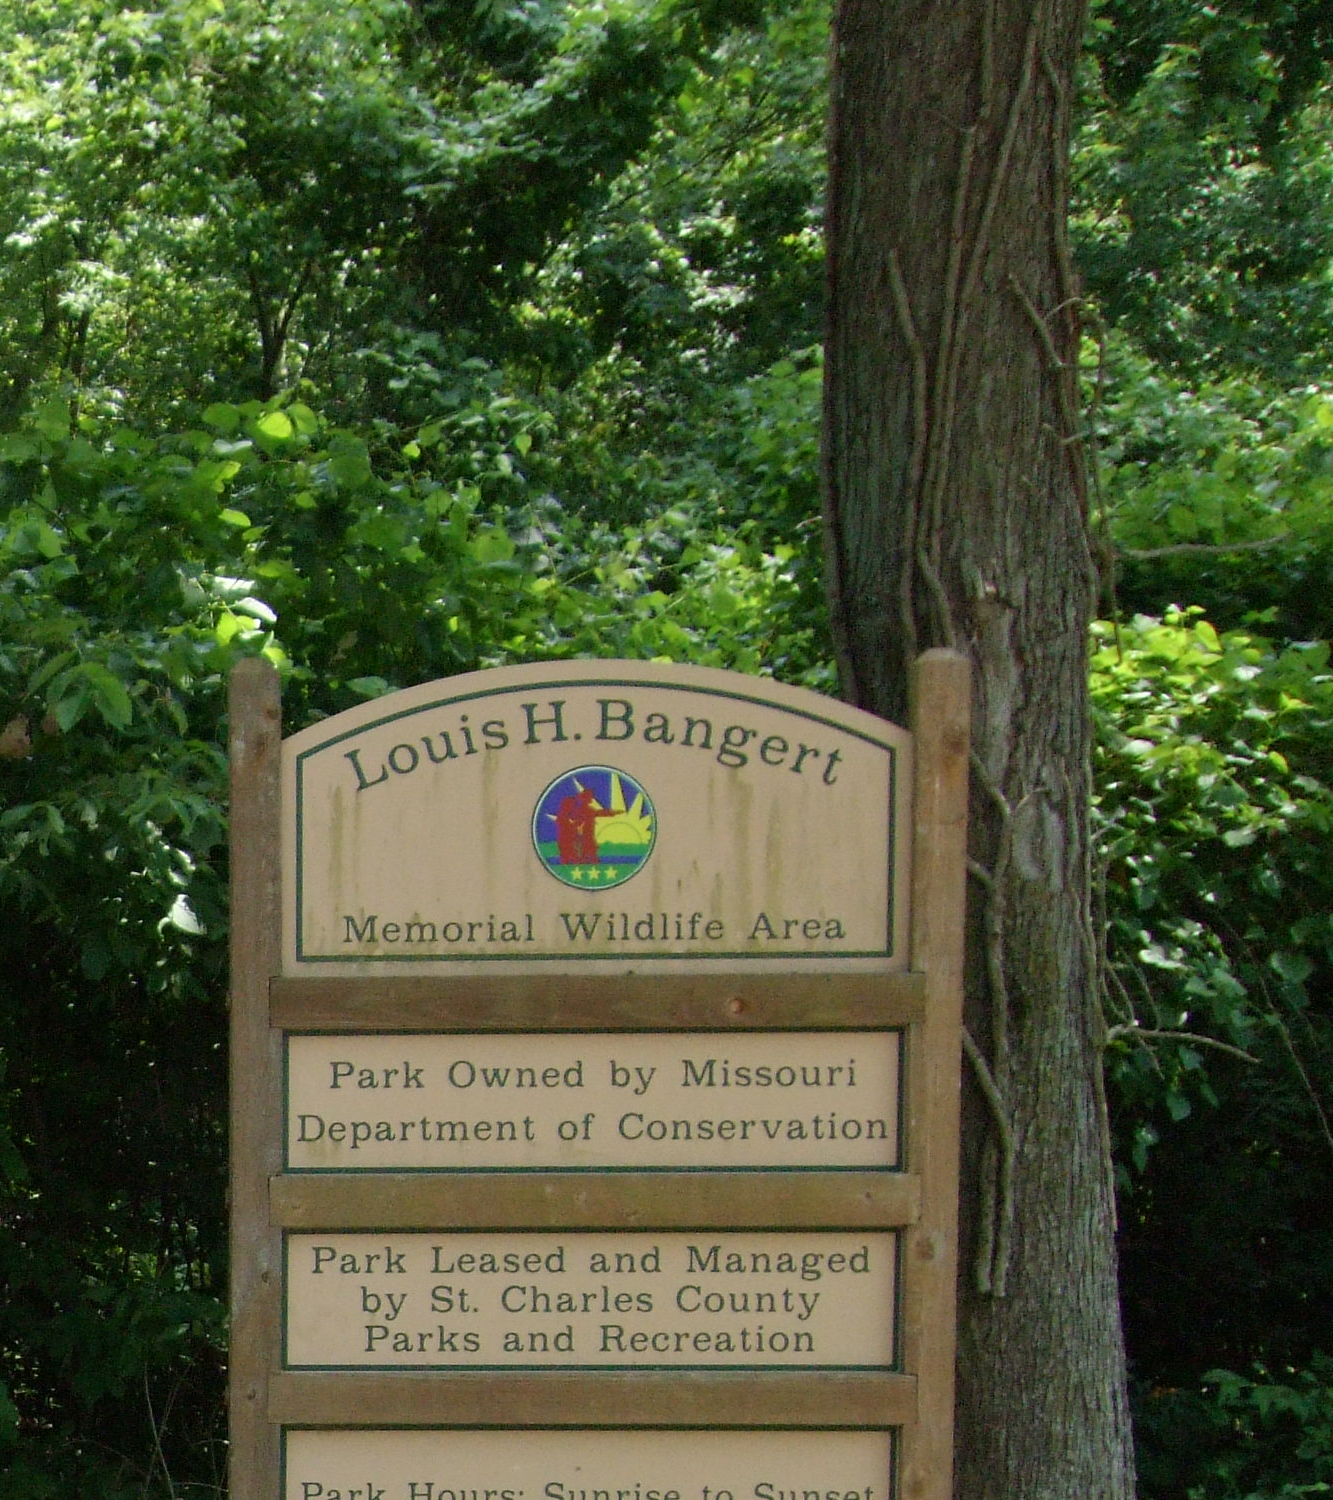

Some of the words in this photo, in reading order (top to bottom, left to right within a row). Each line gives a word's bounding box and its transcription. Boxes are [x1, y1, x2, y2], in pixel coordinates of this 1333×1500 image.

[344, 710, 509, 792] Louis
[521, 701, 581, 744] H.
[597, 699, 844, 786] Bangert
[343, 914, 534, 943] Memorial
[560, 913, 723, 941] Wildlife
[750, 913, 846, 940] Area
[330, 1062, 424, 1088] Park
[449, 1061, 583, 1088] Owned
[610, 1060, 656, 1095] by
[682, 1059, 857, 1087] Missouri
[297, 1115, 534, 1149] Department
[558, 1113, 595, 1140] of
[619, 1113, 888, 1140] Conservation
[312, 1247, 406, 1273] Park
[430, 1246, 581, 1274] Leased
[590, 1246, 661, 1273] and
[687, 1246, 869, 1281] Managed
[361, 1286, 407, 1320] by
[432, 1286, 479, 1313] St.
[502, 1286, 652, 1312] Charles
[677, 1285, 819, 1320] County
[365, 1326, 479, 1352] Parks
[504, 1325, 574, 1352] and
[600, 1325, 813, 1352] Recreation
